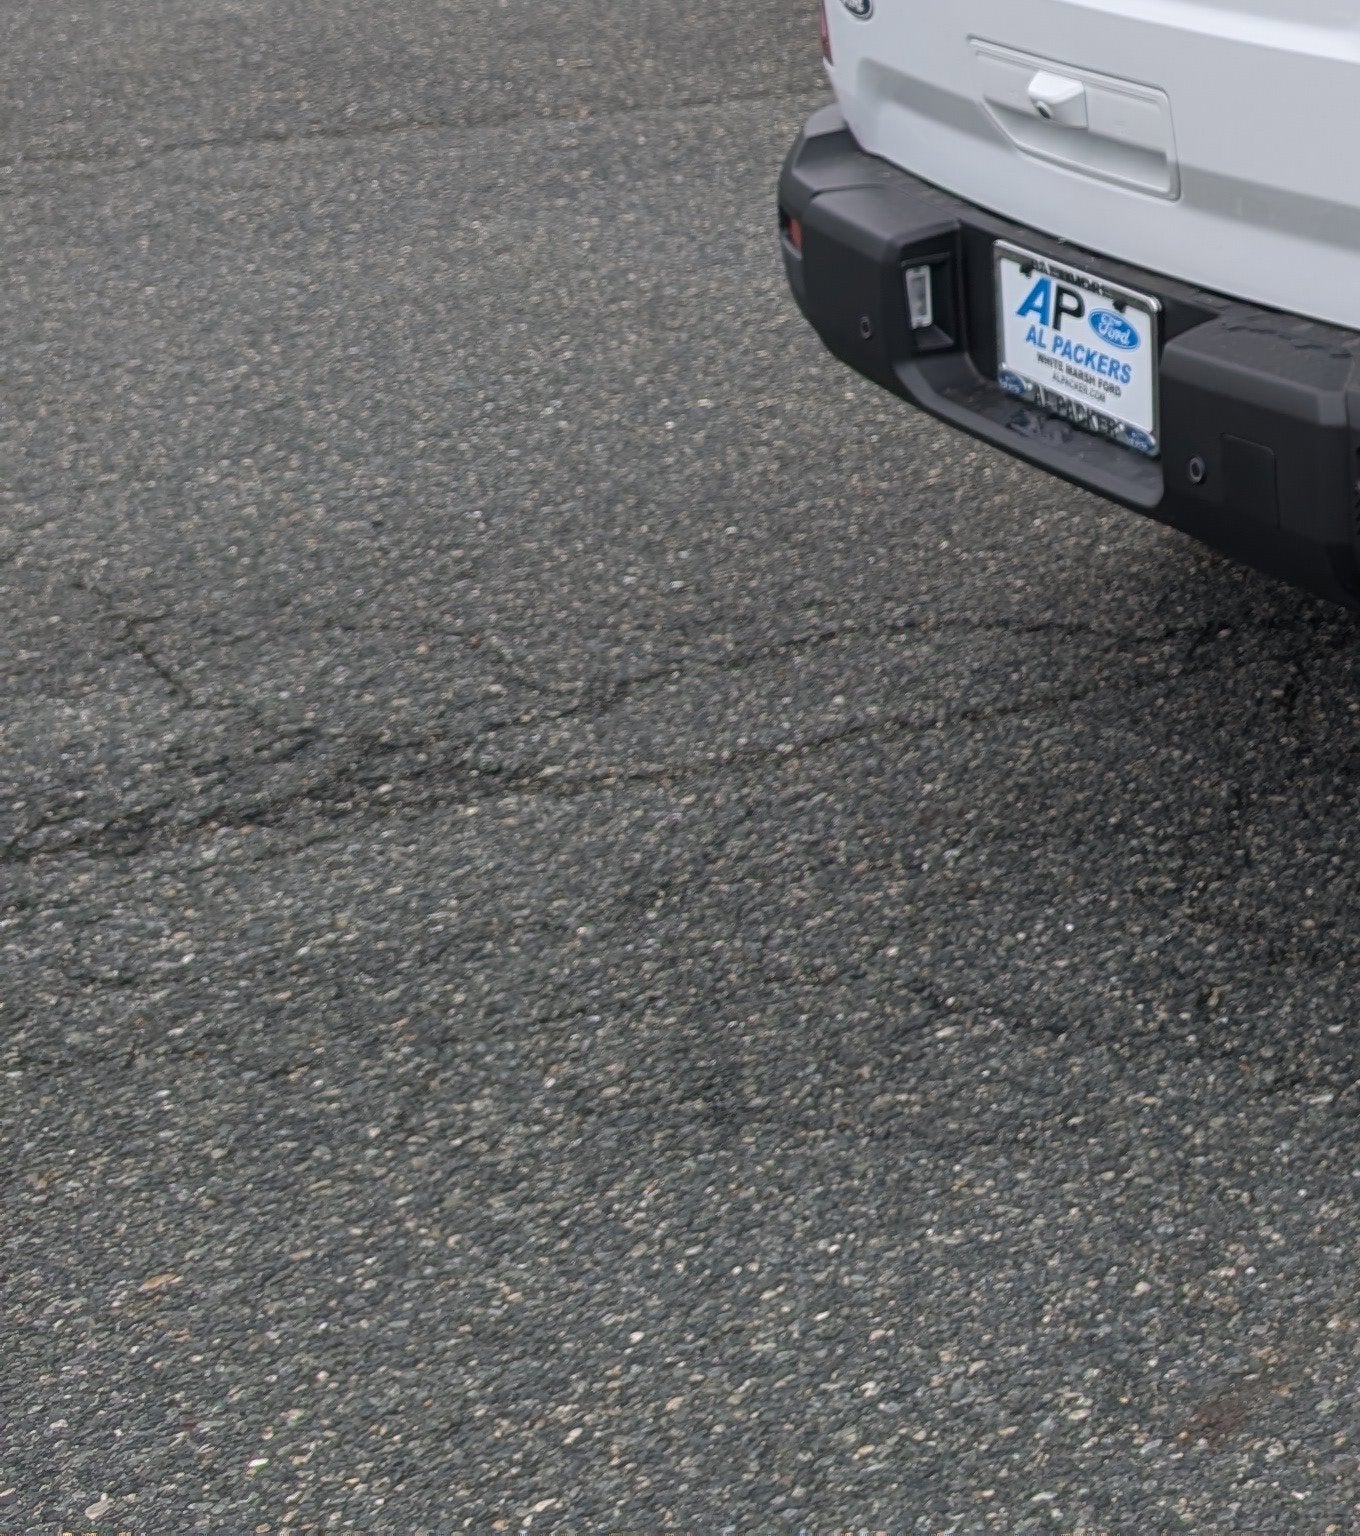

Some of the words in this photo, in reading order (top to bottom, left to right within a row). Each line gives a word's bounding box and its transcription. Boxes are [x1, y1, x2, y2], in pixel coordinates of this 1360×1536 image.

[1016, 276, 1086, 331] AP
[1026, 325, 1046, 349] AL
[1052, 335, 1132, 384] PACKERS
[1037, 352, 1064, 372] WHITE
[1065, 364, 1096, 386] MARSH
[1097, 377, 1122, 398] FORD
